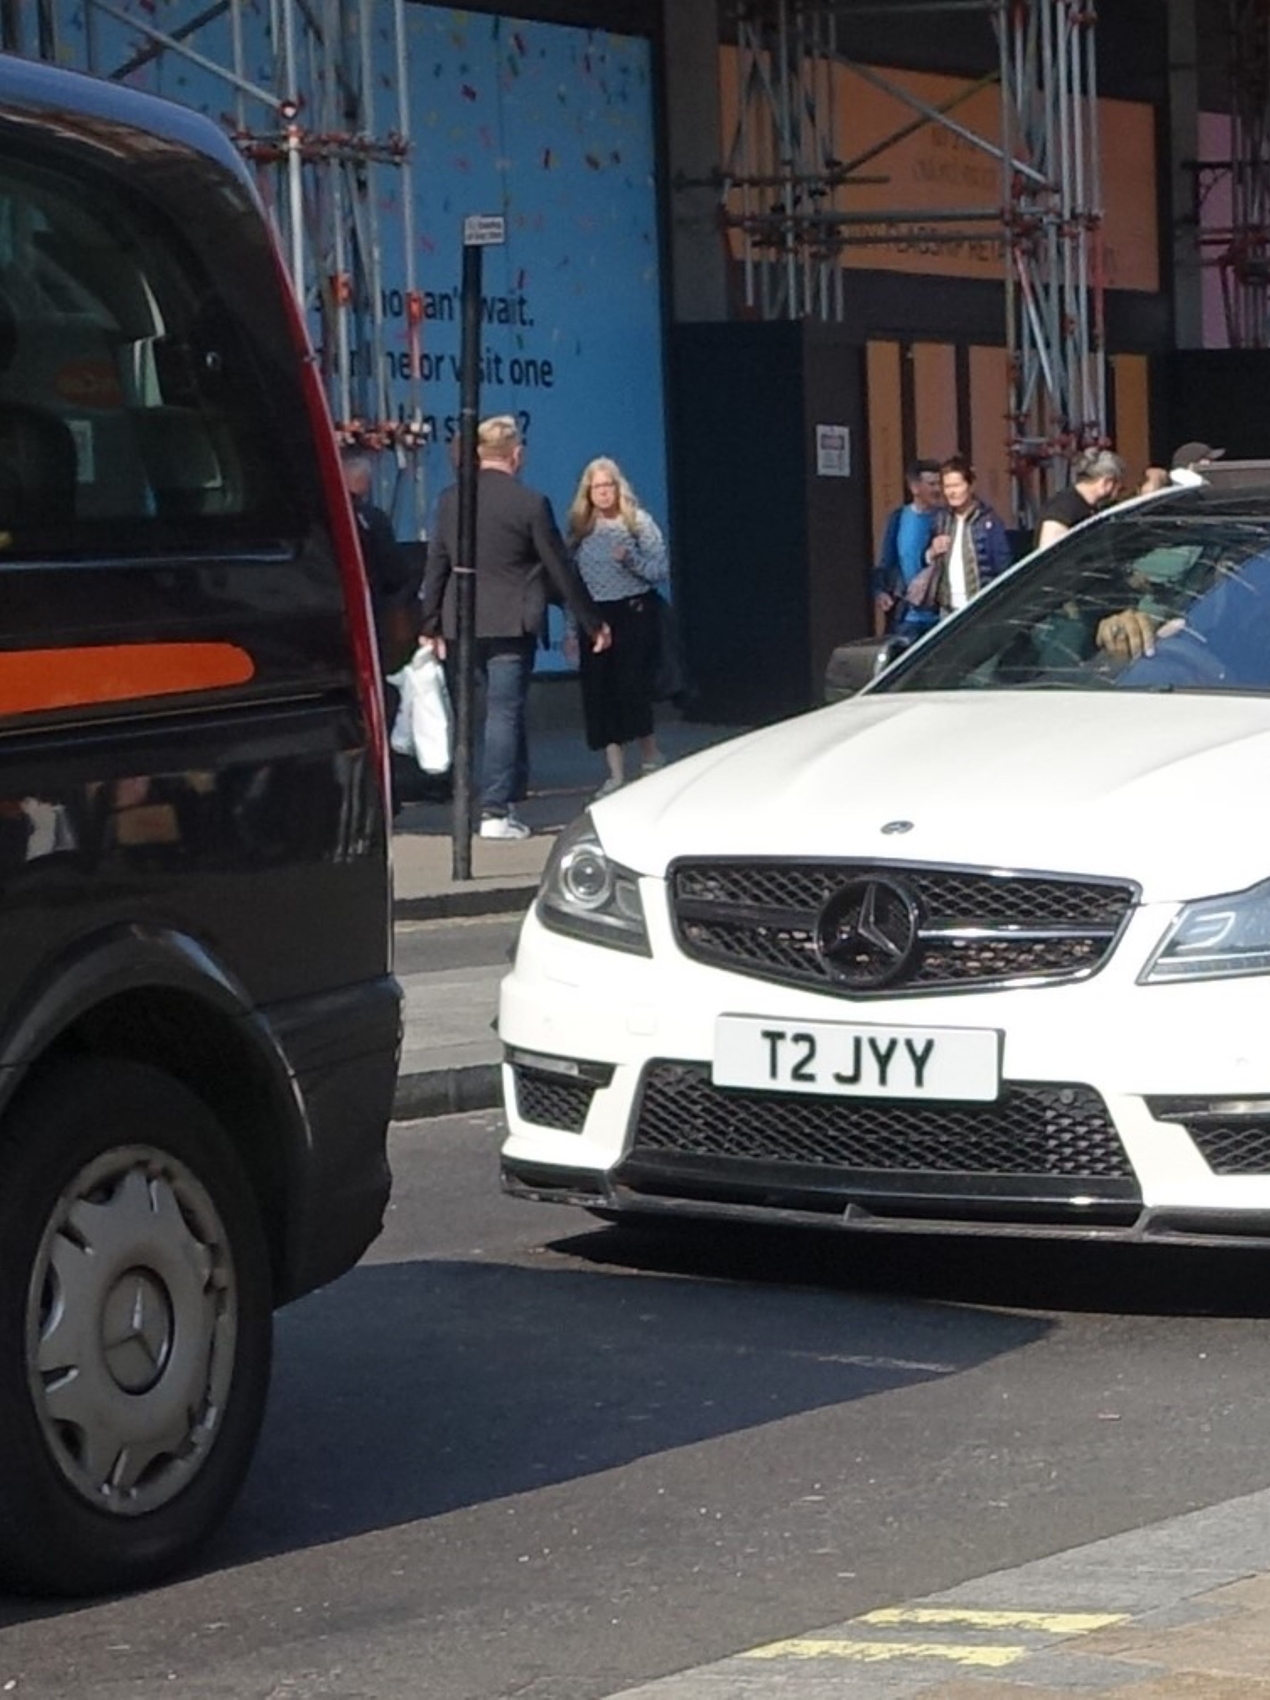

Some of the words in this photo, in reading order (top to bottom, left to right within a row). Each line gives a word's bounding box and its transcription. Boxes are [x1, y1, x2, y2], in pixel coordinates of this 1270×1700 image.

[510, 358, 553, 388] one
[761, 1030, 816, 1082] T2
[832, 1036, 934, 1088] JYY
